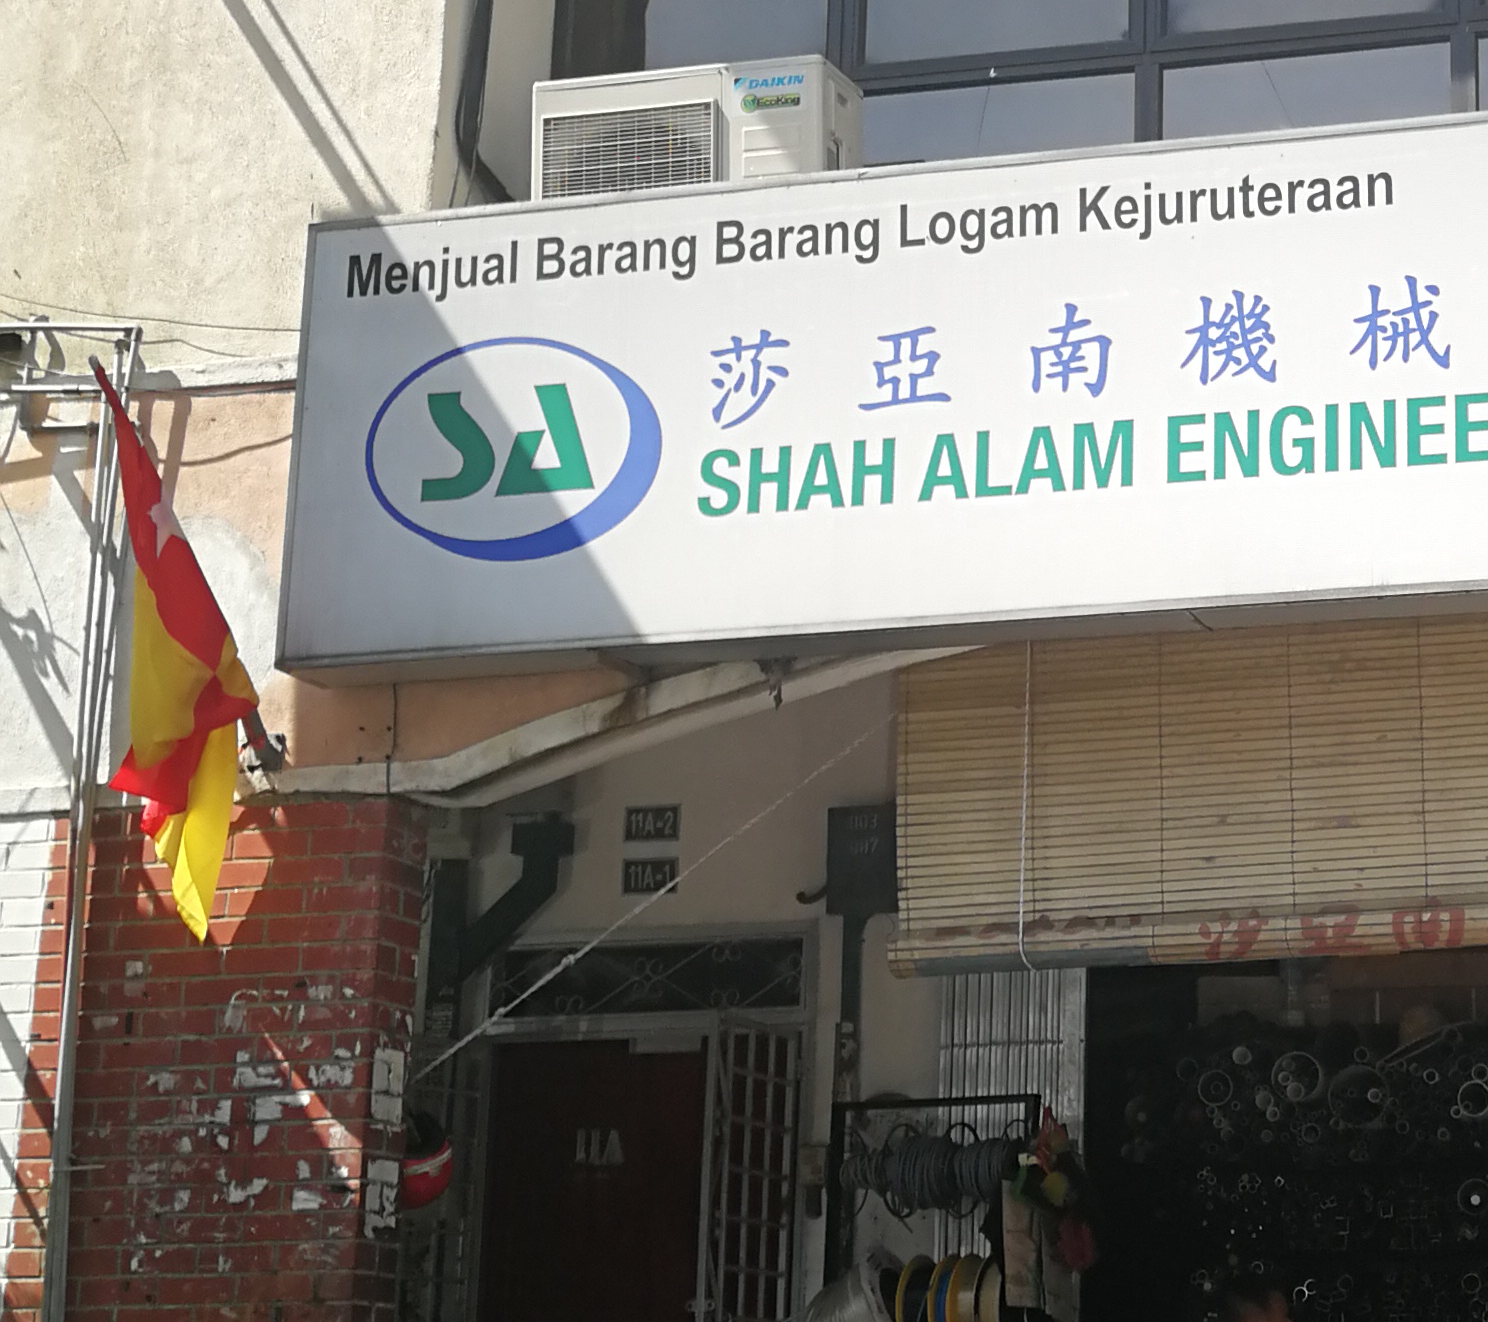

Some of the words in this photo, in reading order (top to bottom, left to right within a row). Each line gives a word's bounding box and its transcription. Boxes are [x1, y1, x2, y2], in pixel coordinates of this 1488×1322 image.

[747, 74, 805, 90] DAIKIN
[757, 94, 800, 107] EcoKing
[346, 241, 519, 303] Menjual
[536, 235, 697, 280] Barang
[716, 218, 880, 264] Barang
[900, 202, 1058, 254] Logam
[1079, 172, 1393, 240] Kejuruteraan
[697, 437, 895, 517] SHAH
[919, 420, 1134, 503] ALAM
[630, 810, 675, 837] 11A-2
[628, 864, 673, 891] 11A-1
